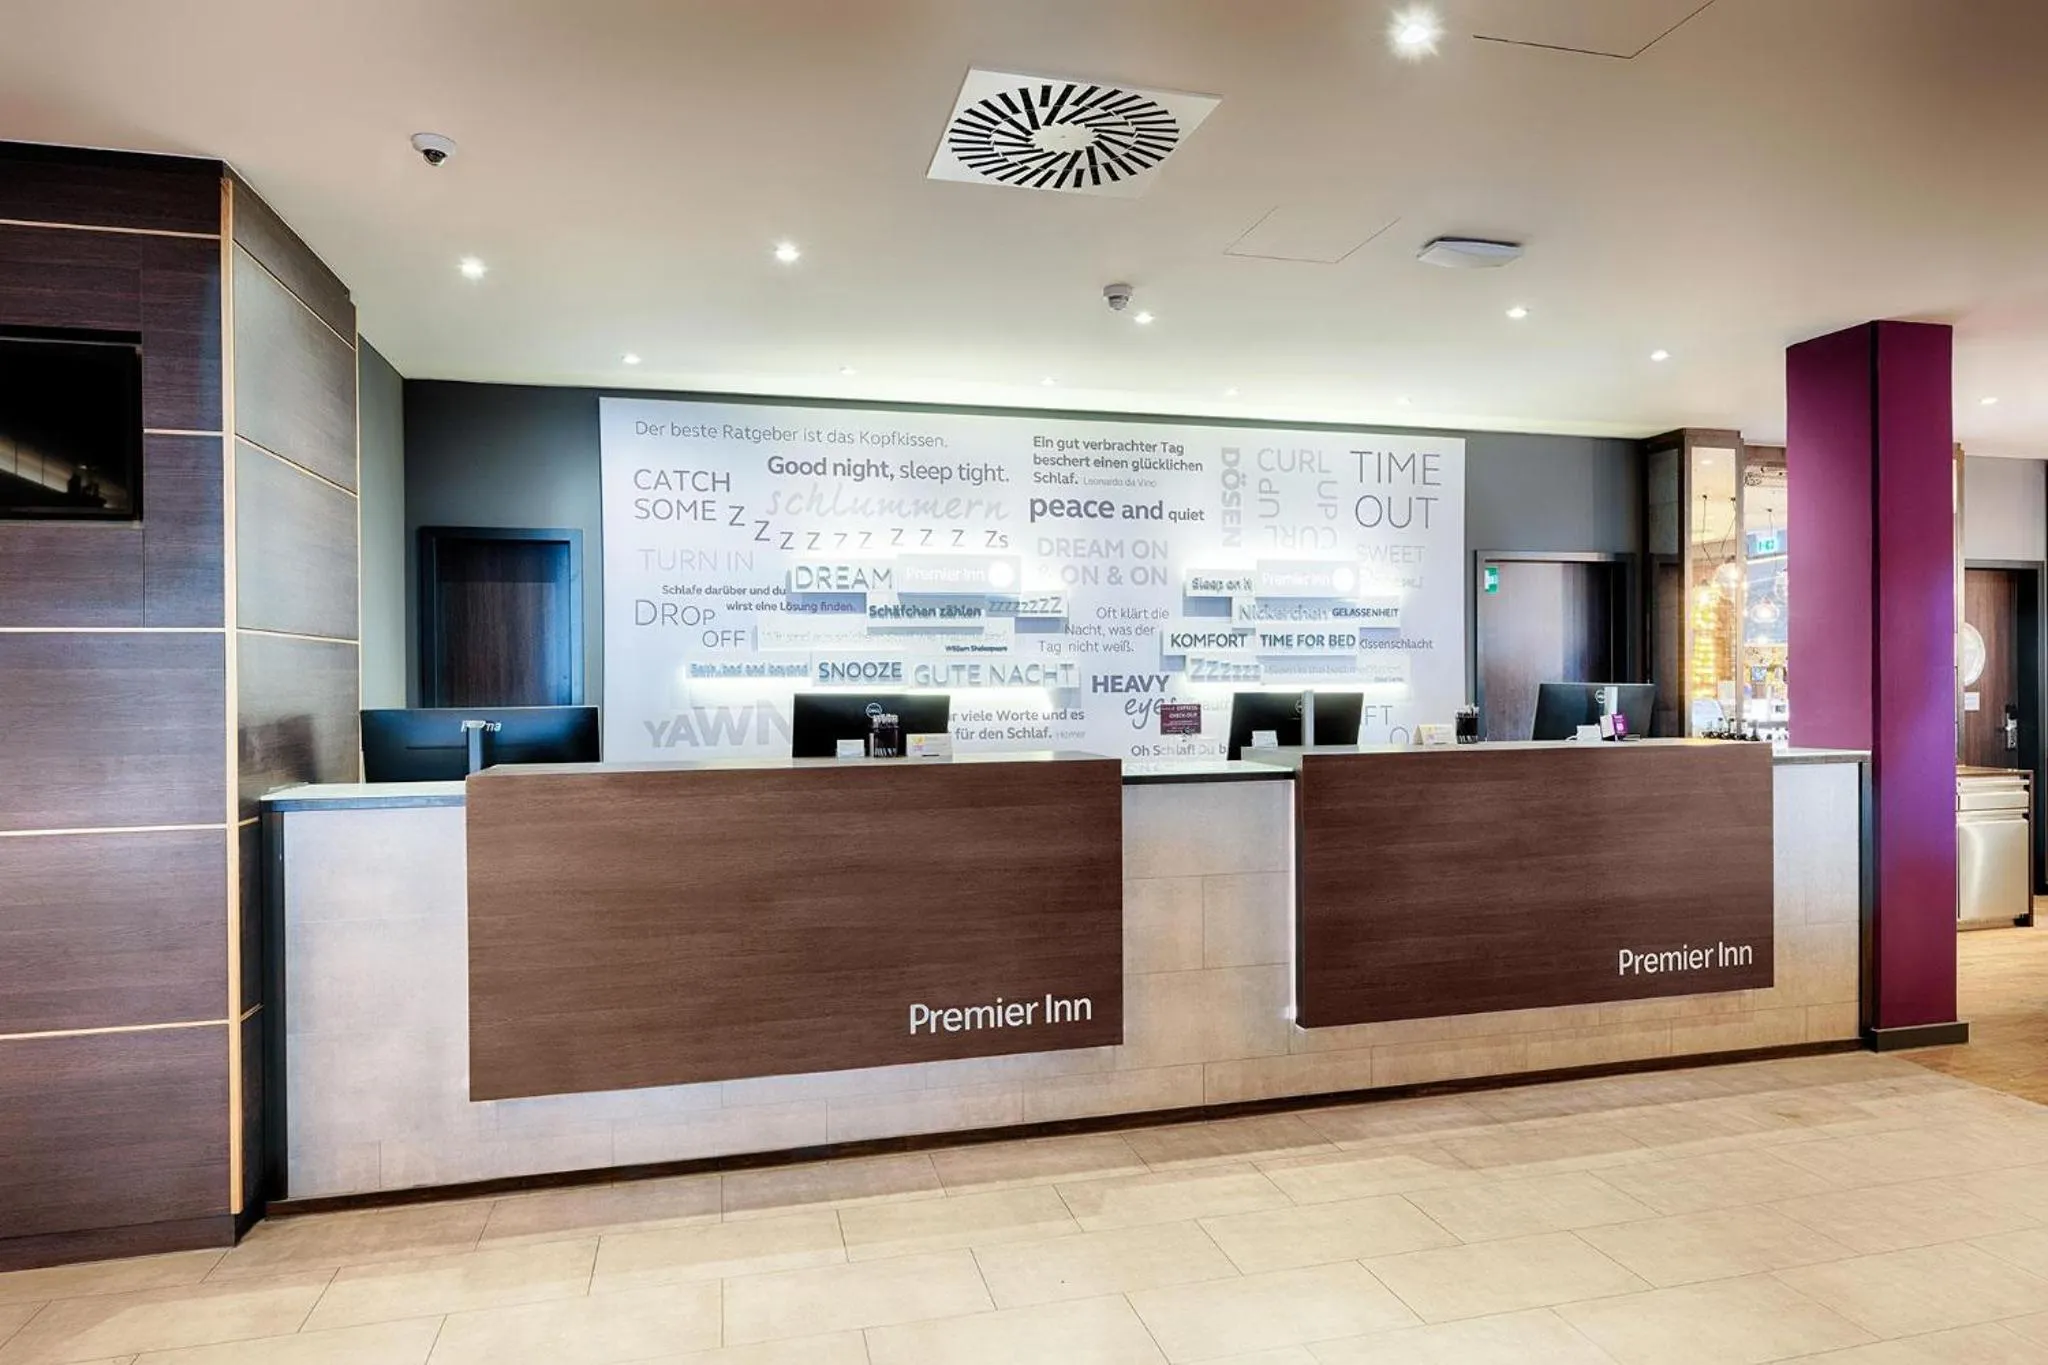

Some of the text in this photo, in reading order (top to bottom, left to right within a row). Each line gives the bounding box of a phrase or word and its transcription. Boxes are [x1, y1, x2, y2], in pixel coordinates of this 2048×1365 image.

[635, 421, 948, 448] Der beste Ratgeber ist das Kopfkissen.
[1033, 436, 1184, 455] Ein gut verbrachter Tag
[767, 456, 1010, 486] Good night, sleep tight.
[1033, 454, 1203, 472] beschert einen glücklichen
[1257, 448, 1333, 474] CURL
[1349, 450, 1442, 485] TIME
[633, 469, 730, 492] CATCH
[1033, 472, 1079, 485] Schlaf.
[766, 482, 1010, 519] schlummern
[1221, 447, 1247, 548] DÖSEN
[1258, 478, 1280, 518] UP
[1317, 480, 1339, 520] UP
[634, 498, 717, 521] SOME
[1029, 497, 1205, 523] peace and quiet
[1355, 494, 1439, 529] OUT
[1037, 537, 1168, 559] DREAM ON
[1358, 544, 1426, 564] SWEET
[637, 548, 754, 572] TURN IN
[795, 566, 893, 590] DREAM
[1061, 565, 1099, 585] ON
[1106, 565, 1124, 585] &
[1130, 566, 1168, 586] ON
[662, 585, 701, 596] Schlafe
[705, 585, 746, 596] darüber
[750, 585, 770, 596] und
[634, 599, 716, 627] DROP
[726, 601, 856, 614] wirst eine Lösung finden.
[868, 604, 982, 619] Schäfchen zählen
[1096, 606, 1170, 620] Oft klärt die
[1332, 607, 1399, 617] GELASSENHEIT
[702, 630, 746, 648] OFF
[1064, 624, 1156, 637] Nacht, was der
[1170, 633, 1247, 648] KOMFORT
[1259, 634, 1294, 647] TIME
[1297, 634, 1325, 648] FOR
[1328, 634, 1356, 648] BED
[1038, 640, 1135, 655] Tag nicht weiß.
[818, 661, 903, 679] SNOOZE
[914, 663, 1075, 686] GUTE NACHT
[1091, 674, 1170, 693] HEAVY
[643, 700, 793, 748] YAWN
[961, 710, 993, 722] viele
[996, 710, 1039, 722] Worte
[1042, 708, 1067, 721] und
[1070, 710, 1085, 720] es
[956, 727, 975, 740] für
[979, 727, 1003, 740] den
[1007, 726, 1052, 740] Schlaf.
[1131, 744, 1150, 757] Oh
[1618, 941, 1753, 976] Premier Inn
[909, 993, 1092, 1035] Premier Inn
